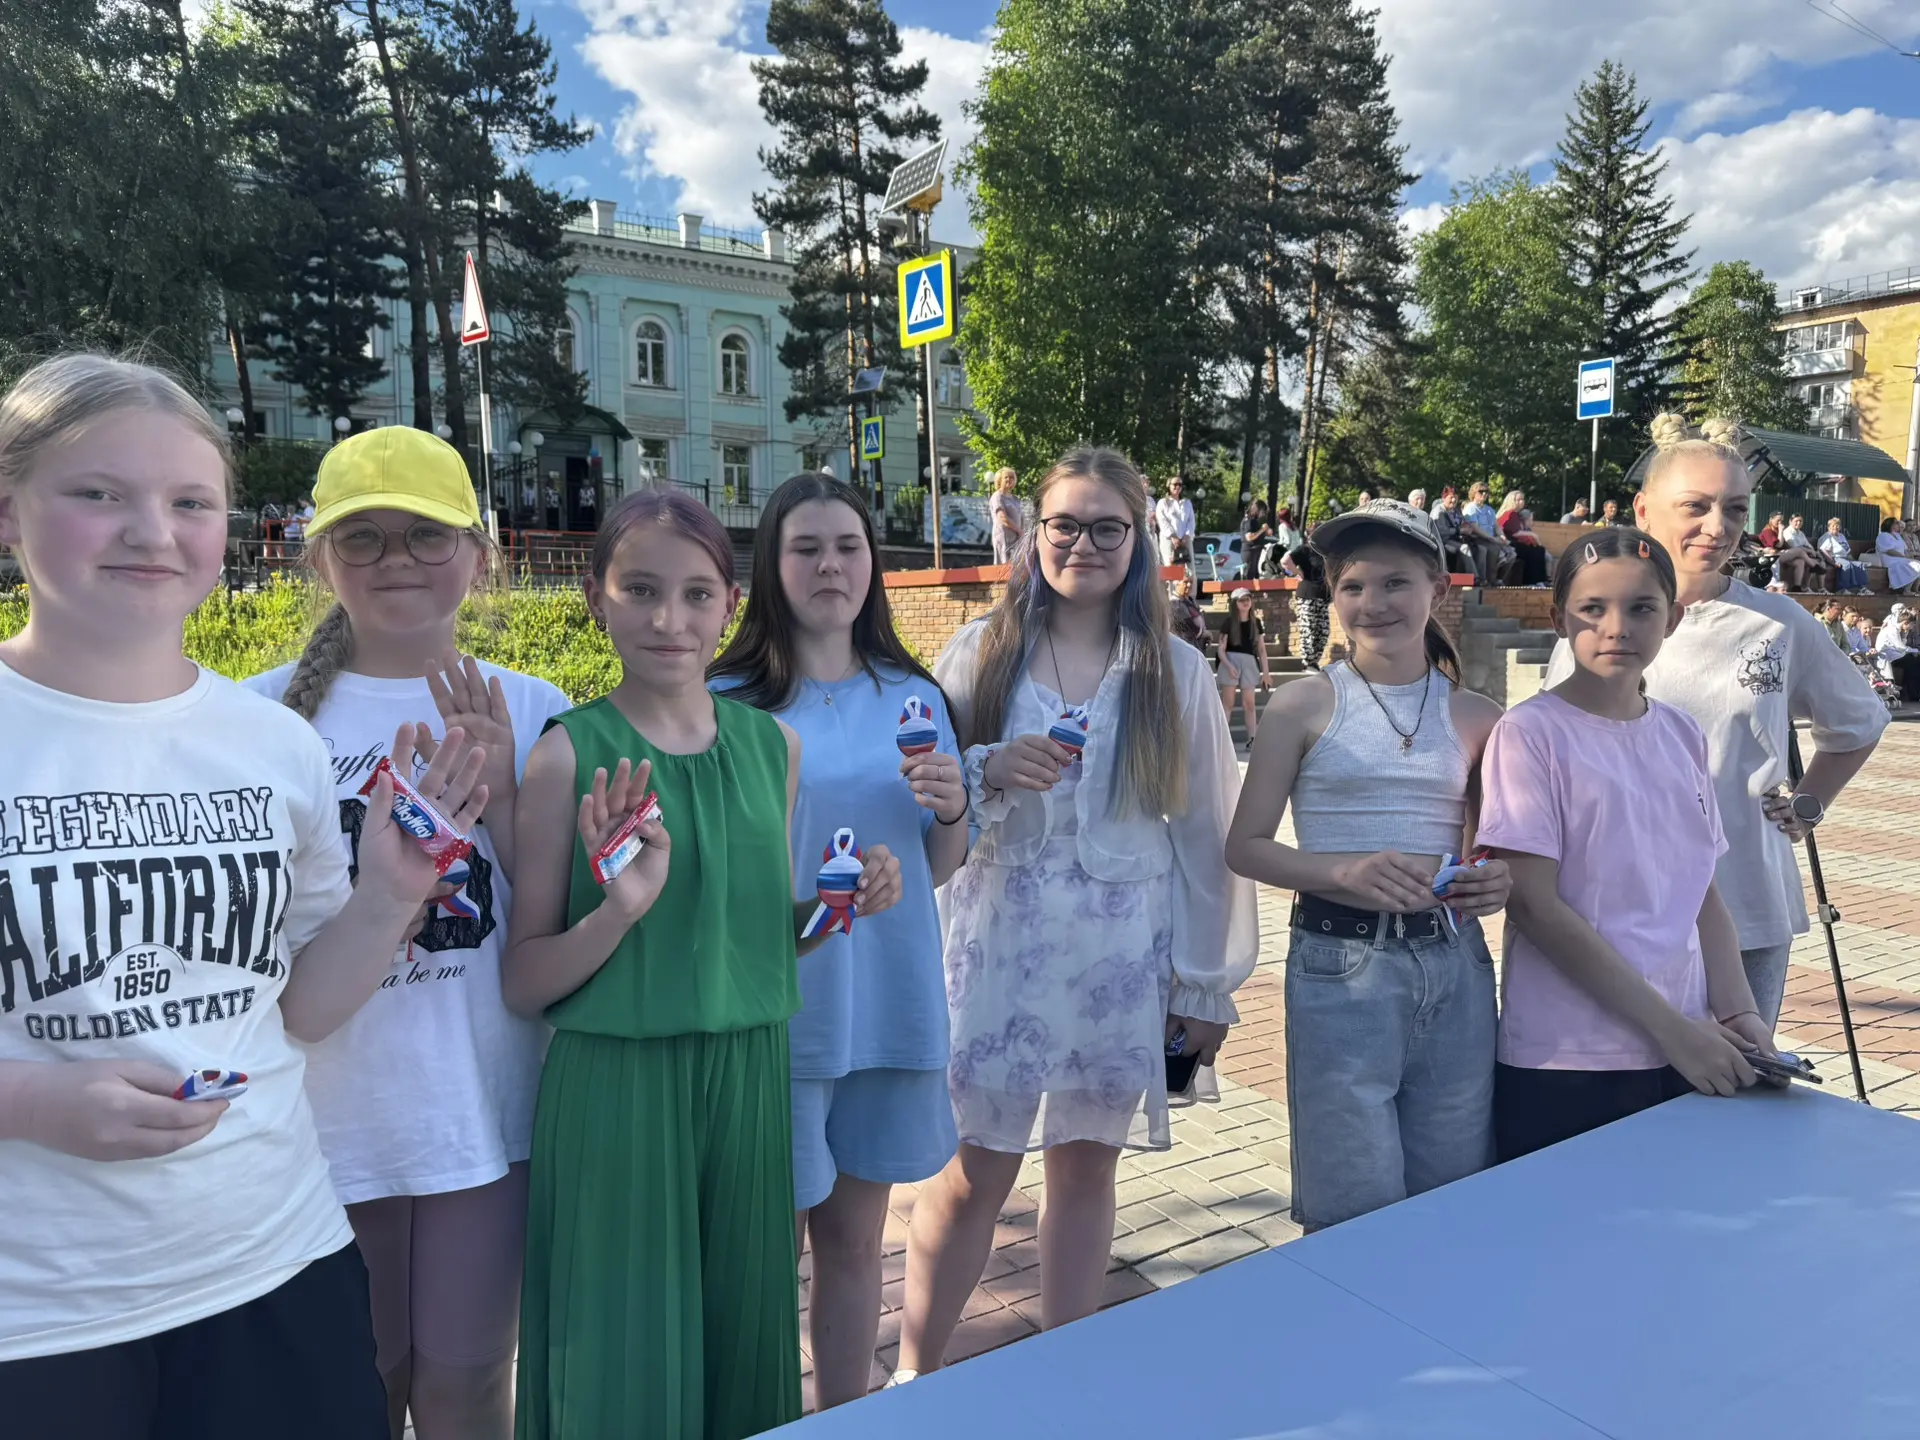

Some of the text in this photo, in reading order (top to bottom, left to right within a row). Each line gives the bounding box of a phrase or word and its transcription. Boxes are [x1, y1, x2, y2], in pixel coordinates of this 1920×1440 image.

[0, 786, 273, 859] LEGENDARY
[0, 848, 293, 1013] ALIFORNI
[126, 951, 160, 971] EST.
[405, 961, 431, 986] be
[436, 964, 466, 980] me
[114, 968, 171, 1002] 1850
[24, 985, 257, 1042] GOLDEN STATE
